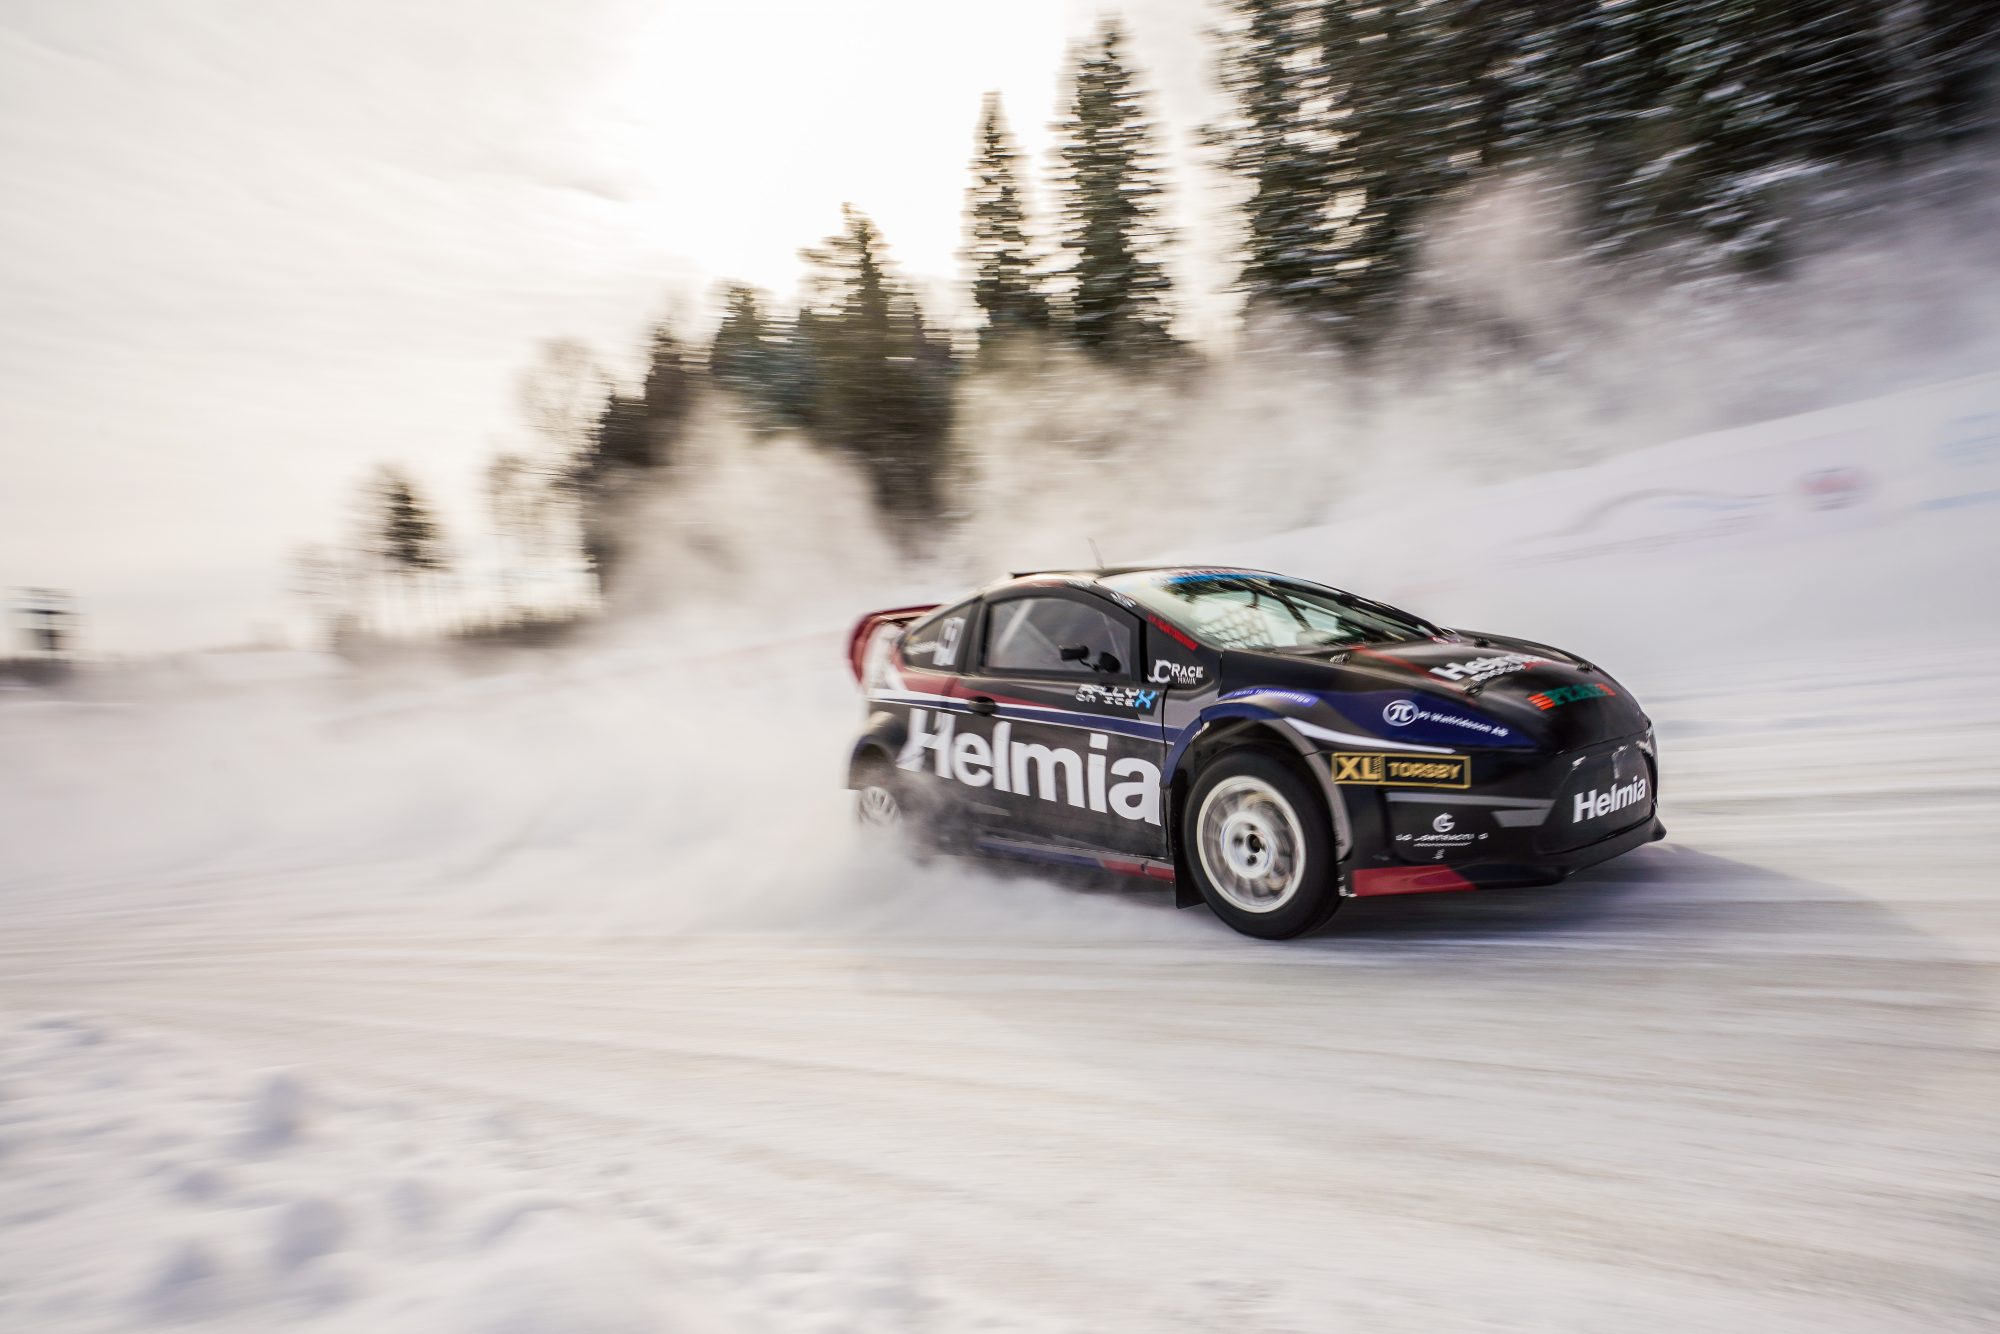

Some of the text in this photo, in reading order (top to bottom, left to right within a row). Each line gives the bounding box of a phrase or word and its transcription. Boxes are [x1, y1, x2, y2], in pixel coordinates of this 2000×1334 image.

[1171, 663, 1203, 678] RACE
[897, 708, 1162, 826] Helmia
[1335, 756, 1379, 780] XL
[1572, 775, 1646, 823] Helmia
